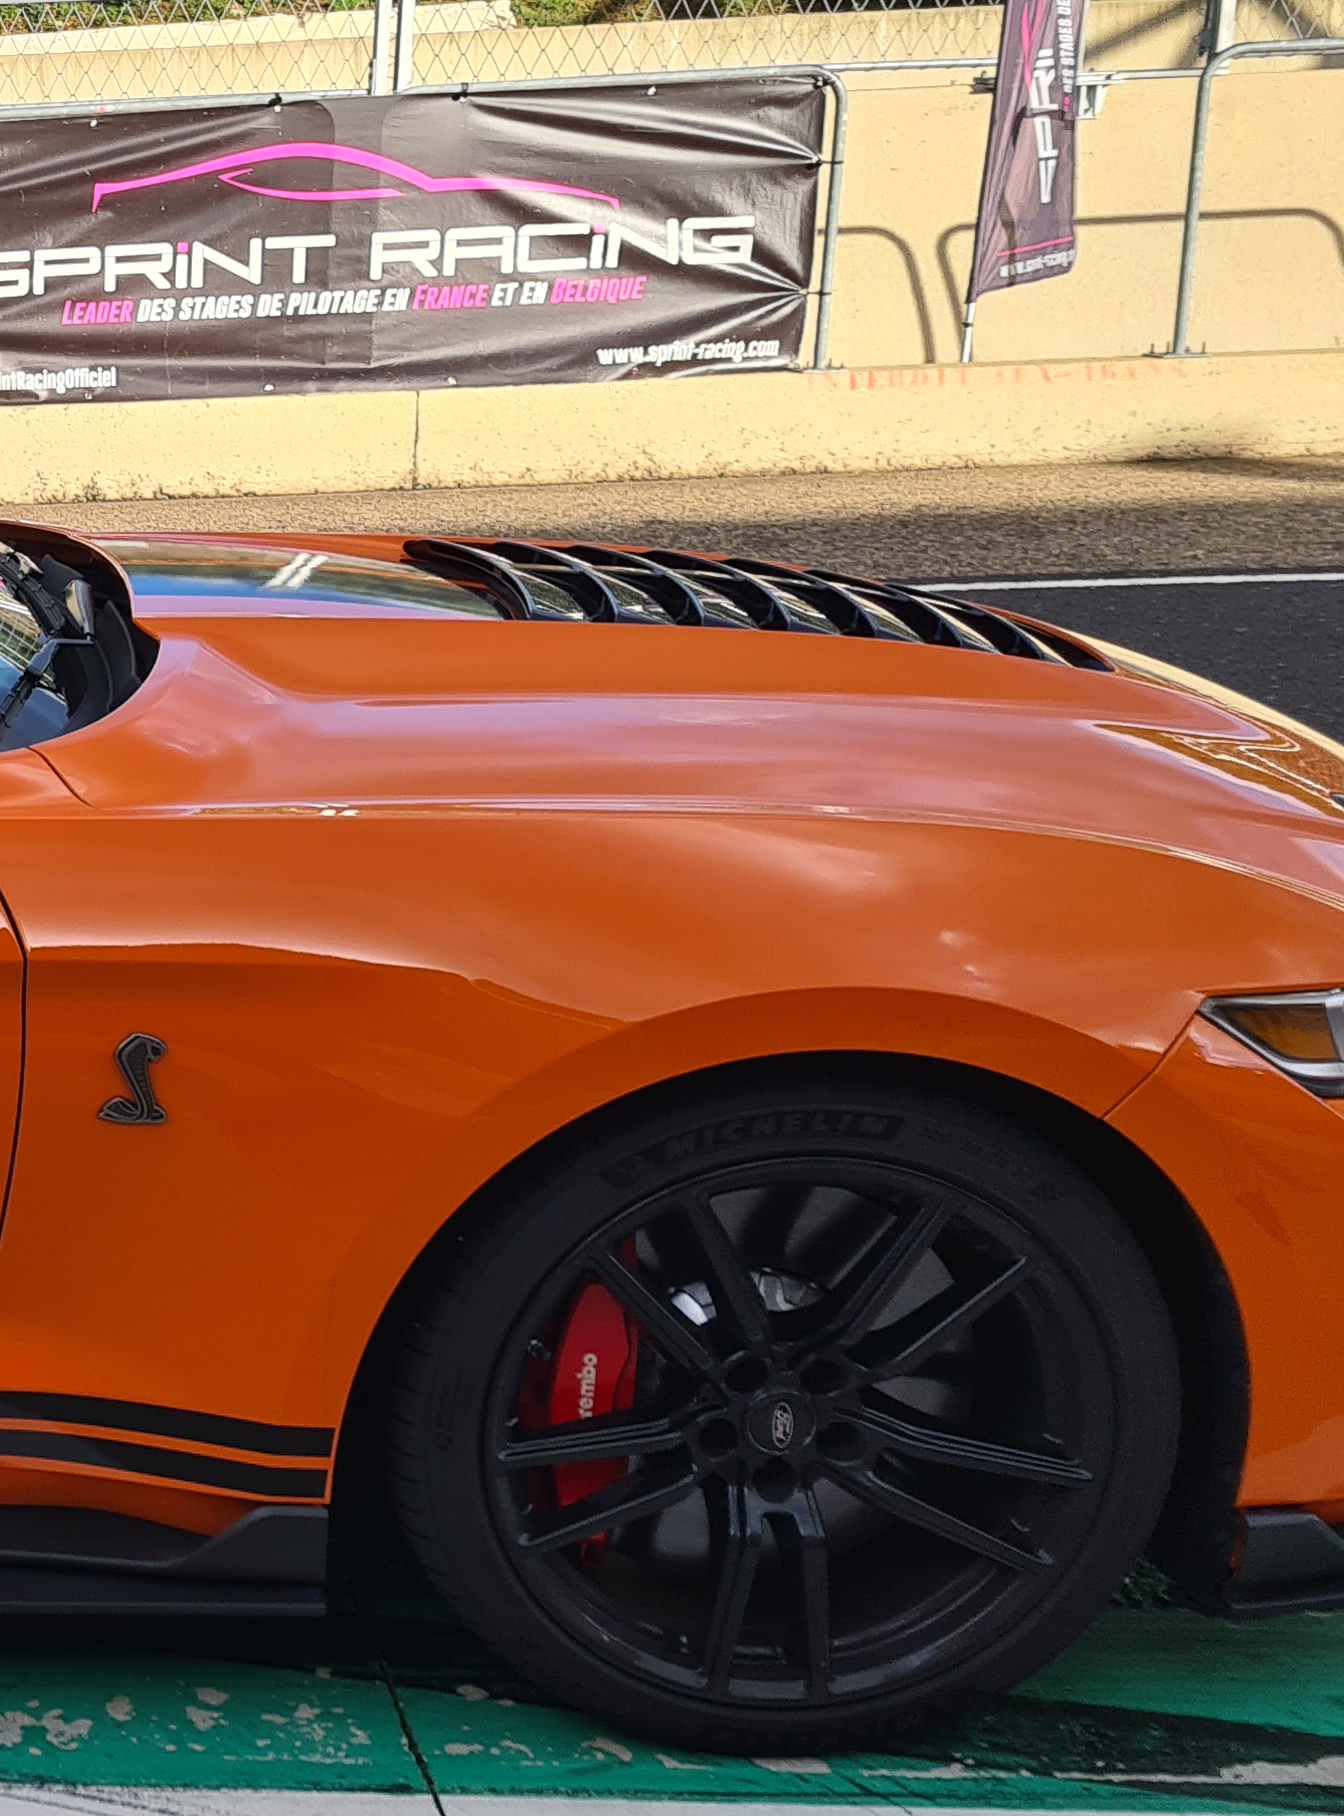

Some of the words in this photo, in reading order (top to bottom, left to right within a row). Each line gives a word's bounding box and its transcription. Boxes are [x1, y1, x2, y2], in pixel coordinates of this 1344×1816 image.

[137, 297, 175, 323] DES
[177, 294, 254, 322] STAGES
[255, 293, 284, 318] DE
[286, 288, 380, 316] PILOTAGE
[381, 287, 411, 313] EN
[491, 281, 519, 307] ET
[520, 280, 549, 305] EN
[595, 338, 781, 368] www.sprint-racing.com
[662, 1110, 890, 1162] MICHELIN
[576, 1352, 598, 1420] rembo
